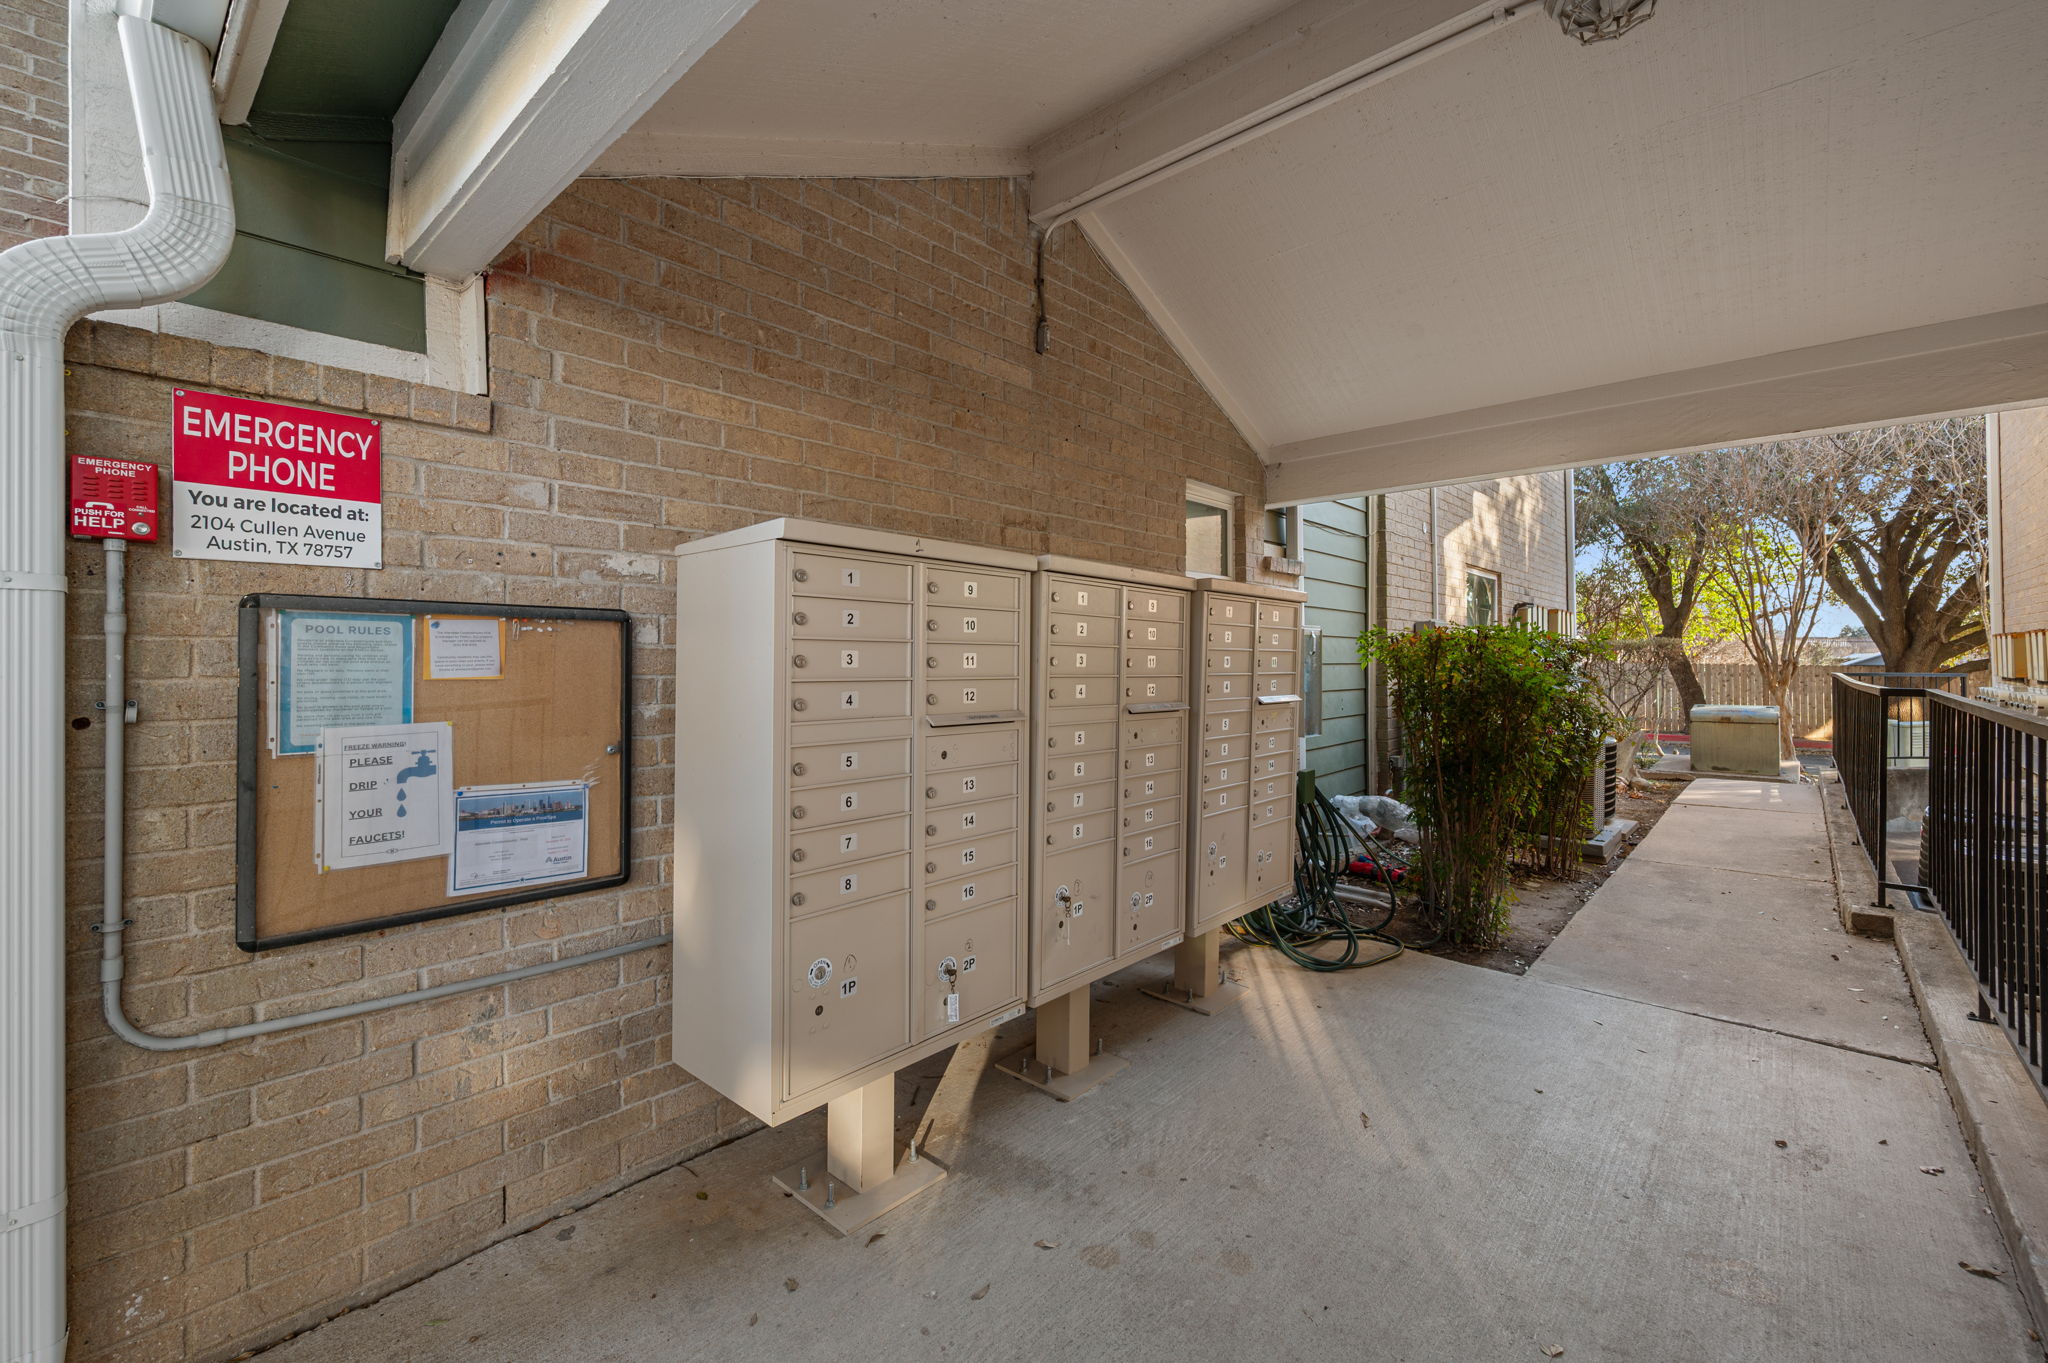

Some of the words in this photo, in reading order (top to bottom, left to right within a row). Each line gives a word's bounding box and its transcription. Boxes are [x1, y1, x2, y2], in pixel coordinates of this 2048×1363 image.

[183, 406, 372, 460] EMERGENCY
[78, 457, 152, 472] EMERGENCY
[95, 467, 136, 478] PHONE
[228, 450, 336, 492] PHONE
[188, 490, 228, 508] You
[233, 497, 266, 512] are
[272, 498, 342, 520] located
[347, 508, 369, 522] at:
[74, 508, 102, 516] PUSH
[74, 516, 125, 529] HELP
[190, 515, 235, 532] 2104
[240, 519, 298, 537] Cullen
[303, 526, 366, 542] Avenue
[206, 536, 271, 554] Austin,
[276, 540, 299, 555] TX
[303, 543, 353, 559] 78757
[847, 572, 853, 584] 1
[968, 584, 974, 595] 9
[1080, 594, 1085, 604] 1
[847, 613, 854, 624] 2
[305, 624, 344, 635] POOL
[348, 625, 391, 635] RULES
[965, 620, 976, 630] 10
[1079, 626, 1084, 634] 2
[1149, 630, 1156, 639] 10
[846, 654, 853, 665] 3
[965, 656, 975, 666] 11
[1079, 656, 1084, 665] 3
[1148, 658, 1156, 667] 11
[1078, 687, 1083, 696] 4
[1148, 686, 1155, 695] 12
[846, 694, 853, 706] 4
[964, 691, 975, 702] 12
[1077, 734, 1082, 743] 5
[372, 741, 406, 750] WARNING!
[349, 756, 393, 768] PLEASE
[845, 756, 852, 768] 5
[1146, 755, 1154, 765] 13
[1076, 765, 1082, 774] 6
[349, 780, 378, 791] DRIP
[964, 779, 975, 791] 13
[1146, 783, 1154, 792] 14
[845, 796, 852, 808] 6
[1076, 796, 1081, 805] 7
[349, 808, 382, 819] YOUR
[1146, 810, 1153, 820] 15
[964, 815, 974, 826] 14
[1076, 827, 1081, 836] 8
[349, 830, 405, 846] FAUCETS!
[1145, 839, 1153, 848] 16
[845, 838, 852, 850] 7
[964, 850, 974, 862] 15
[844, 878, 852, 891] 8
[963, 886, 974, 898] 16
[1145, 894, 1153, 905] 2P
[1073, 904, 1083, 915] 1P
[963, 958, 975, 971] 2P
[841, 980, 856, 995] 1P
